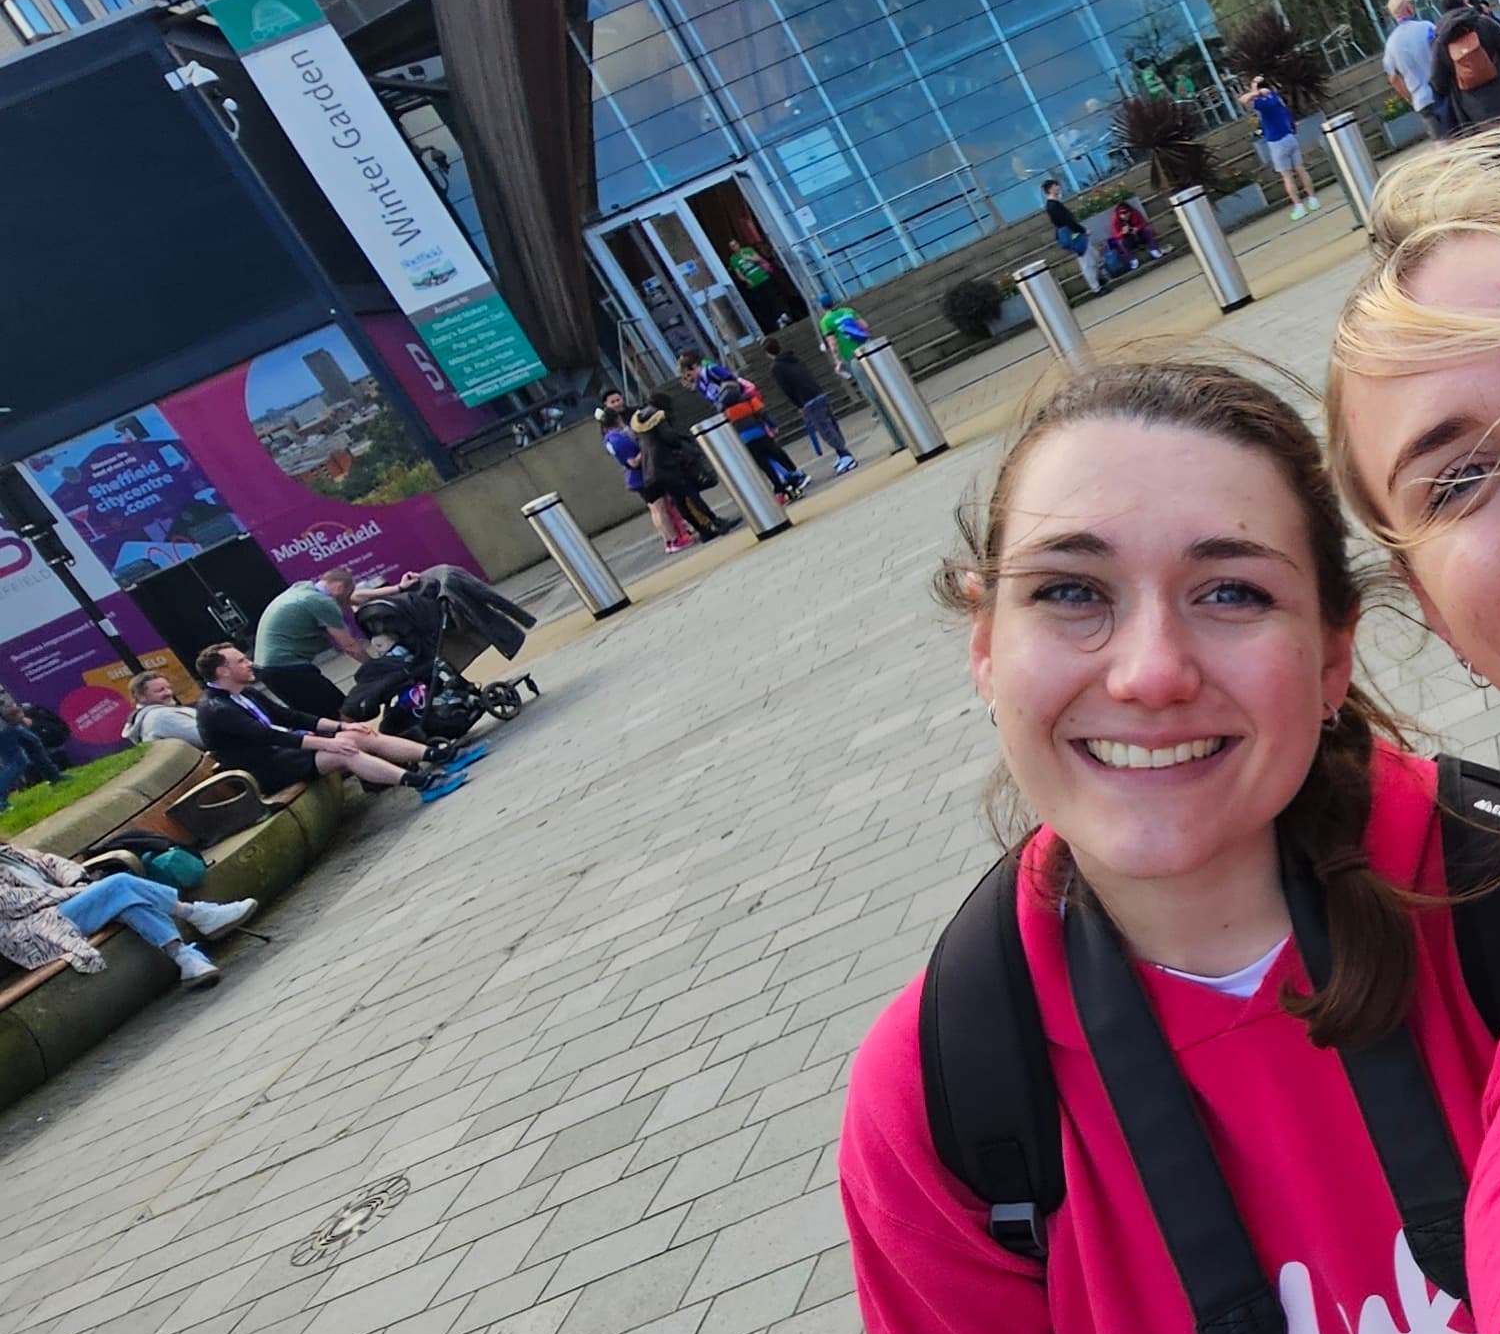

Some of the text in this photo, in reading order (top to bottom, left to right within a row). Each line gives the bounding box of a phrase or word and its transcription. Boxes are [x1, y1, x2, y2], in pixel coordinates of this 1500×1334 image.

[290, 49, 422, 247] Winter Garden
[87, 459, 160, 499] Sheffield
[95, 473, 174, 513] citycentre
[124, 493, 161, 516] .com
[270, 530, 328, 563] Mobile
[308, 519, 383, 562] Sheffield
[106, 655, 168, 679] SHEIELD
